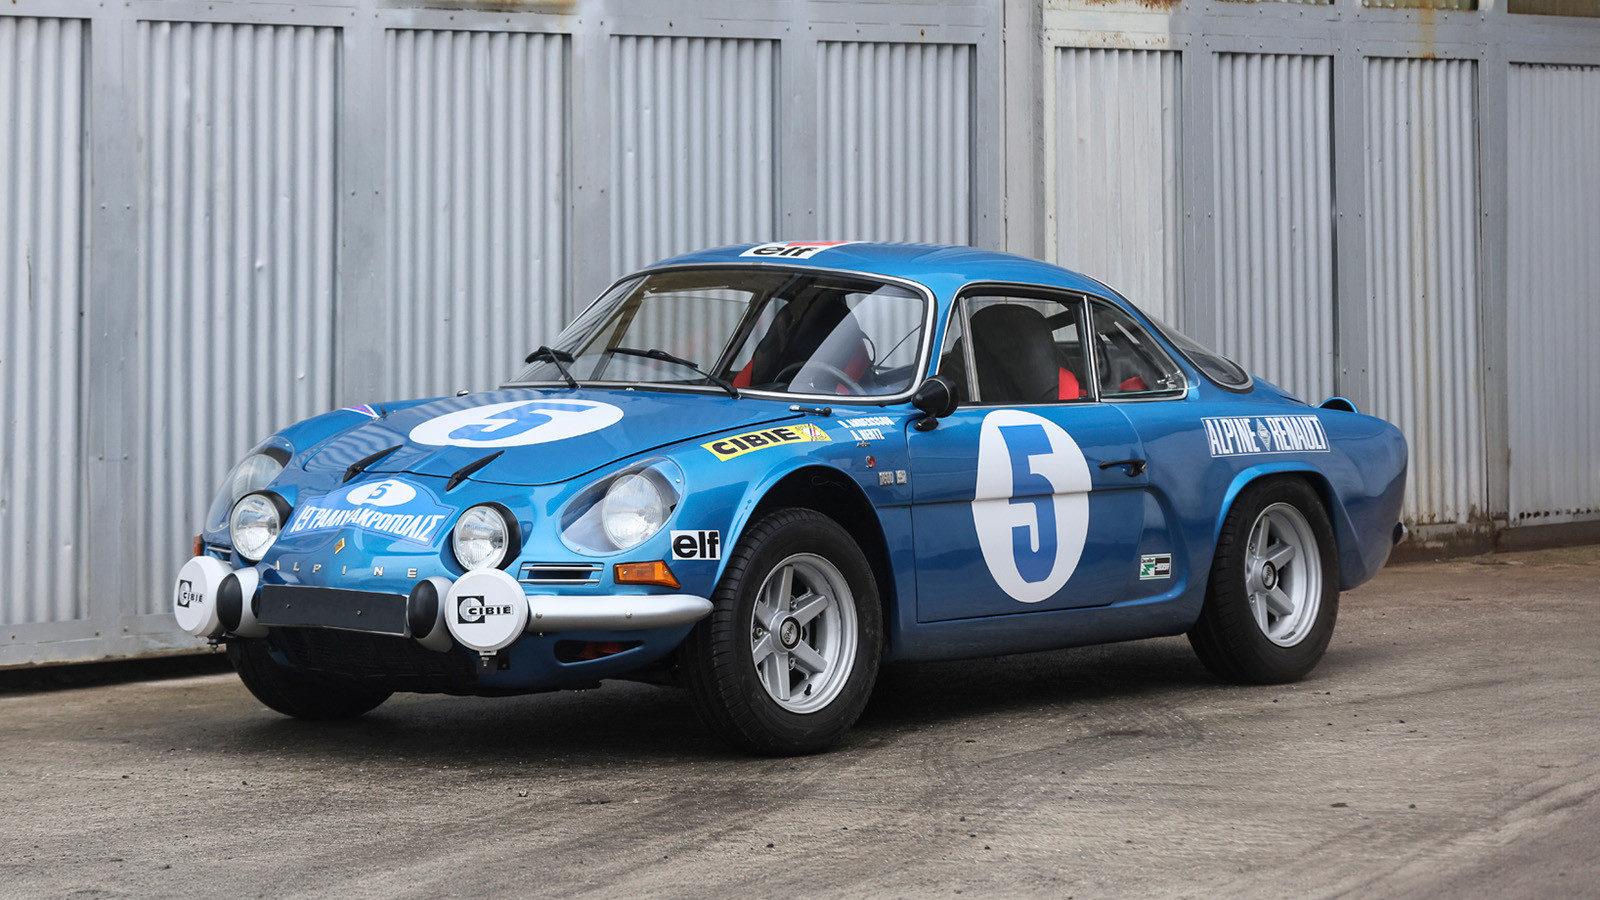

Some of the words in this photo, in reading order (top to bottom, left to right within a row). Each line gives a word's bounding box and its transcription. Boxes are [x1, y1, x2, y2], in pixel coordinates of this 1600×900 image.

[753, 247, 818, 257] elf
[448, 402, 599, 441] 5
[1205, 418, 1261, 455] ALPINE
[1264, 416, 1327, 451] RENAULT
[367, 483, 393, 500] 5
[997, 424, 1058, 583] 5
[672, 531, 719, 558] elf
[274, 560, 418, 578] ALPINE
